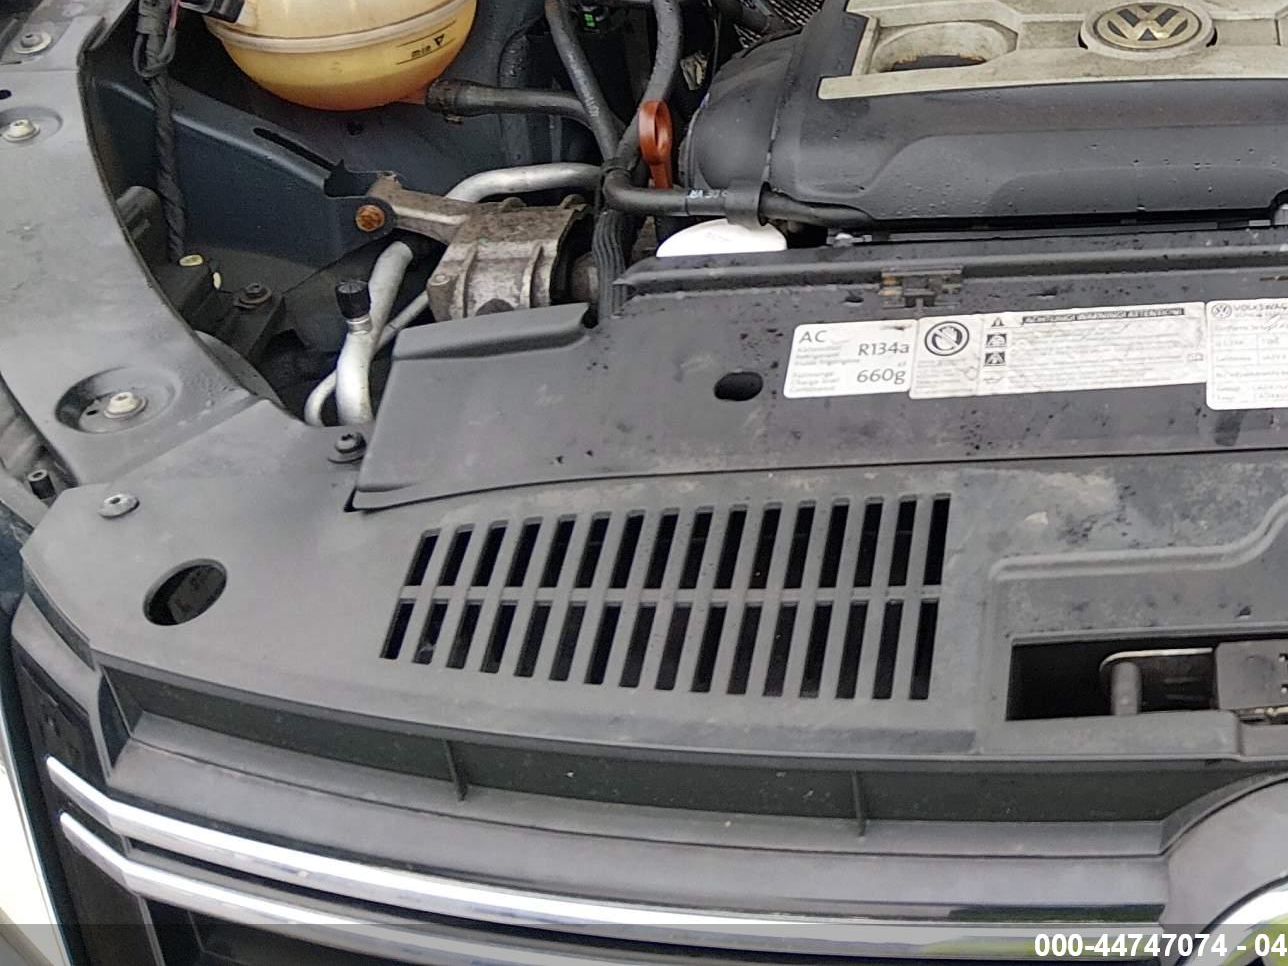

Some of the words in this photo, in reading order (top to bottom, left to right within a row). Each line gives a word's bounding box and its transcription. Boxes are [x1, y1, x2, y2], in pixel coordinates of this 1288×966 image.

[798, 330, 827, 343] AC
[857, 342, 910, 356] R134a
[856, 369, 906, 384] 660g
